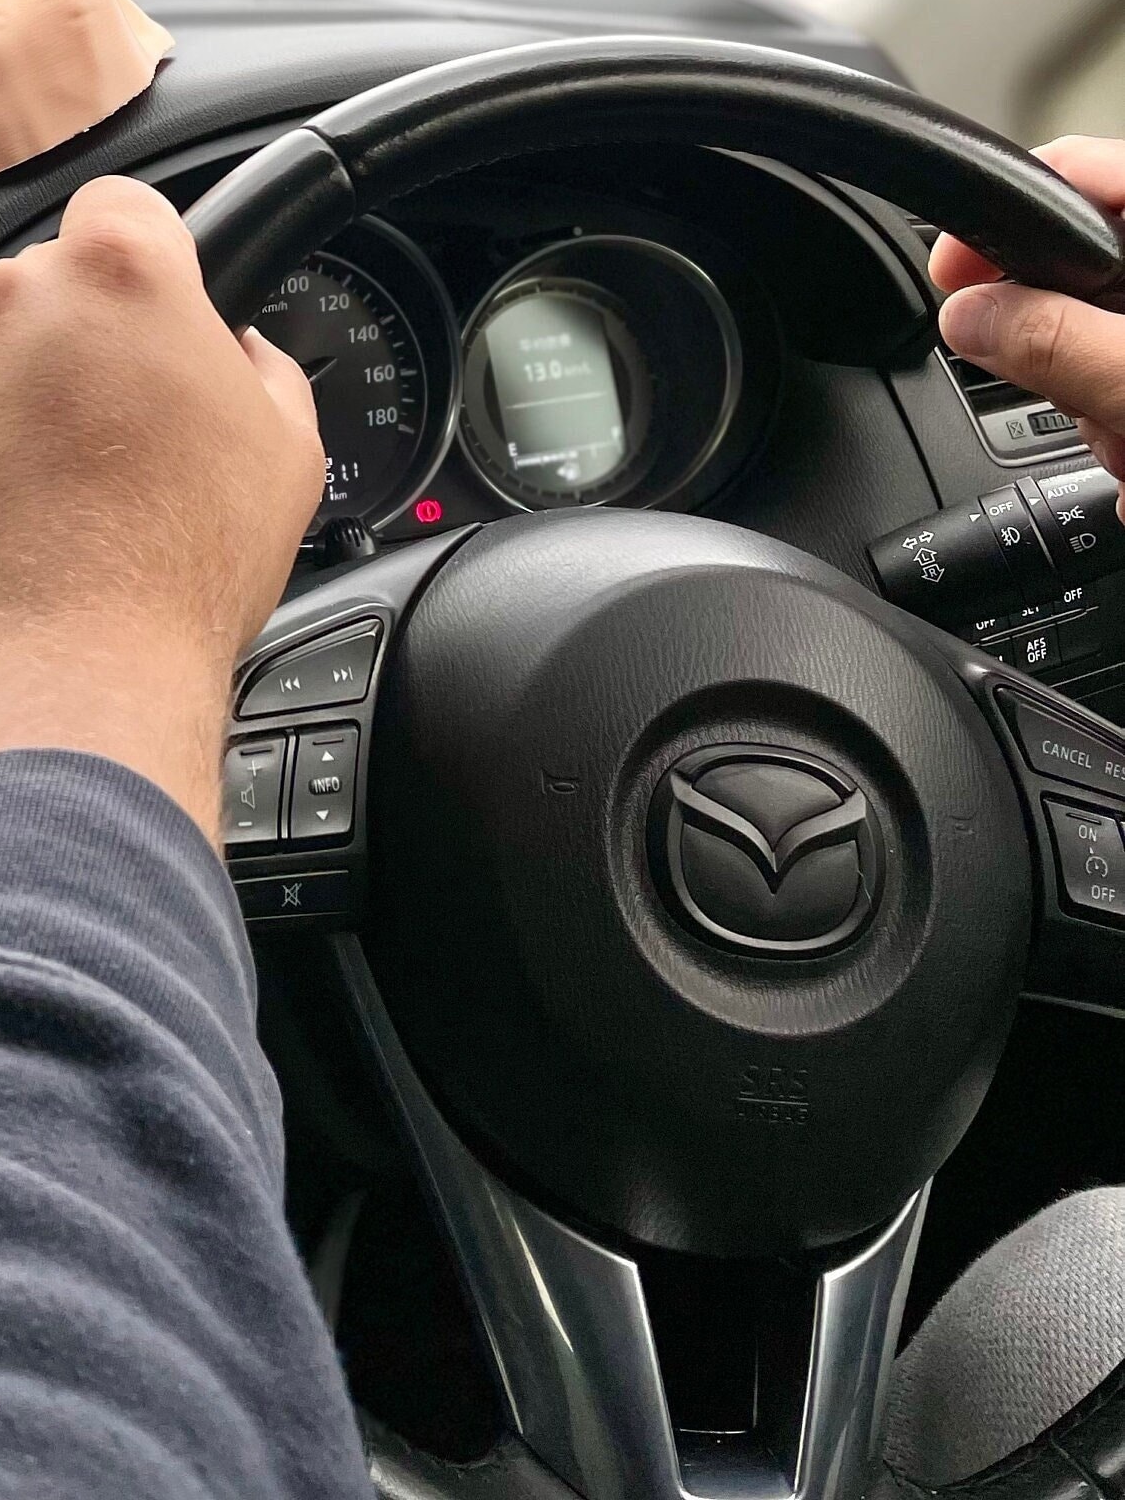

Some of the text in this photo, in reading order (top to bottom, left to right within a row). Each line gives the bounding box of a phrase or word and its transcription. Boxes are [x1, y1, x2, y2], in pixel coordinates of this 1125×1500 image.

[281, 275, 309, 295] 100
[319, 293, 350, 313] 120
[348, 323, 380, 344] 140
[363, 363, 396, 384] 160
[366, 406, 398, 427] 180
[1047, 483, 1079, 499] AUTO
[988, 500, 1014, 518] OFF
[1063, 588, 1083, 603] OFF
[1026, 637, 1047, 653] AFS
[1026, 649, 1047, 664] OFF
[1042, 740, 1092, 769] CANCEL
[313, 776, 340, 793] INFO
[1078, 824, 1097, 842] ON
[1091, 884, 1116, 902] OFF
